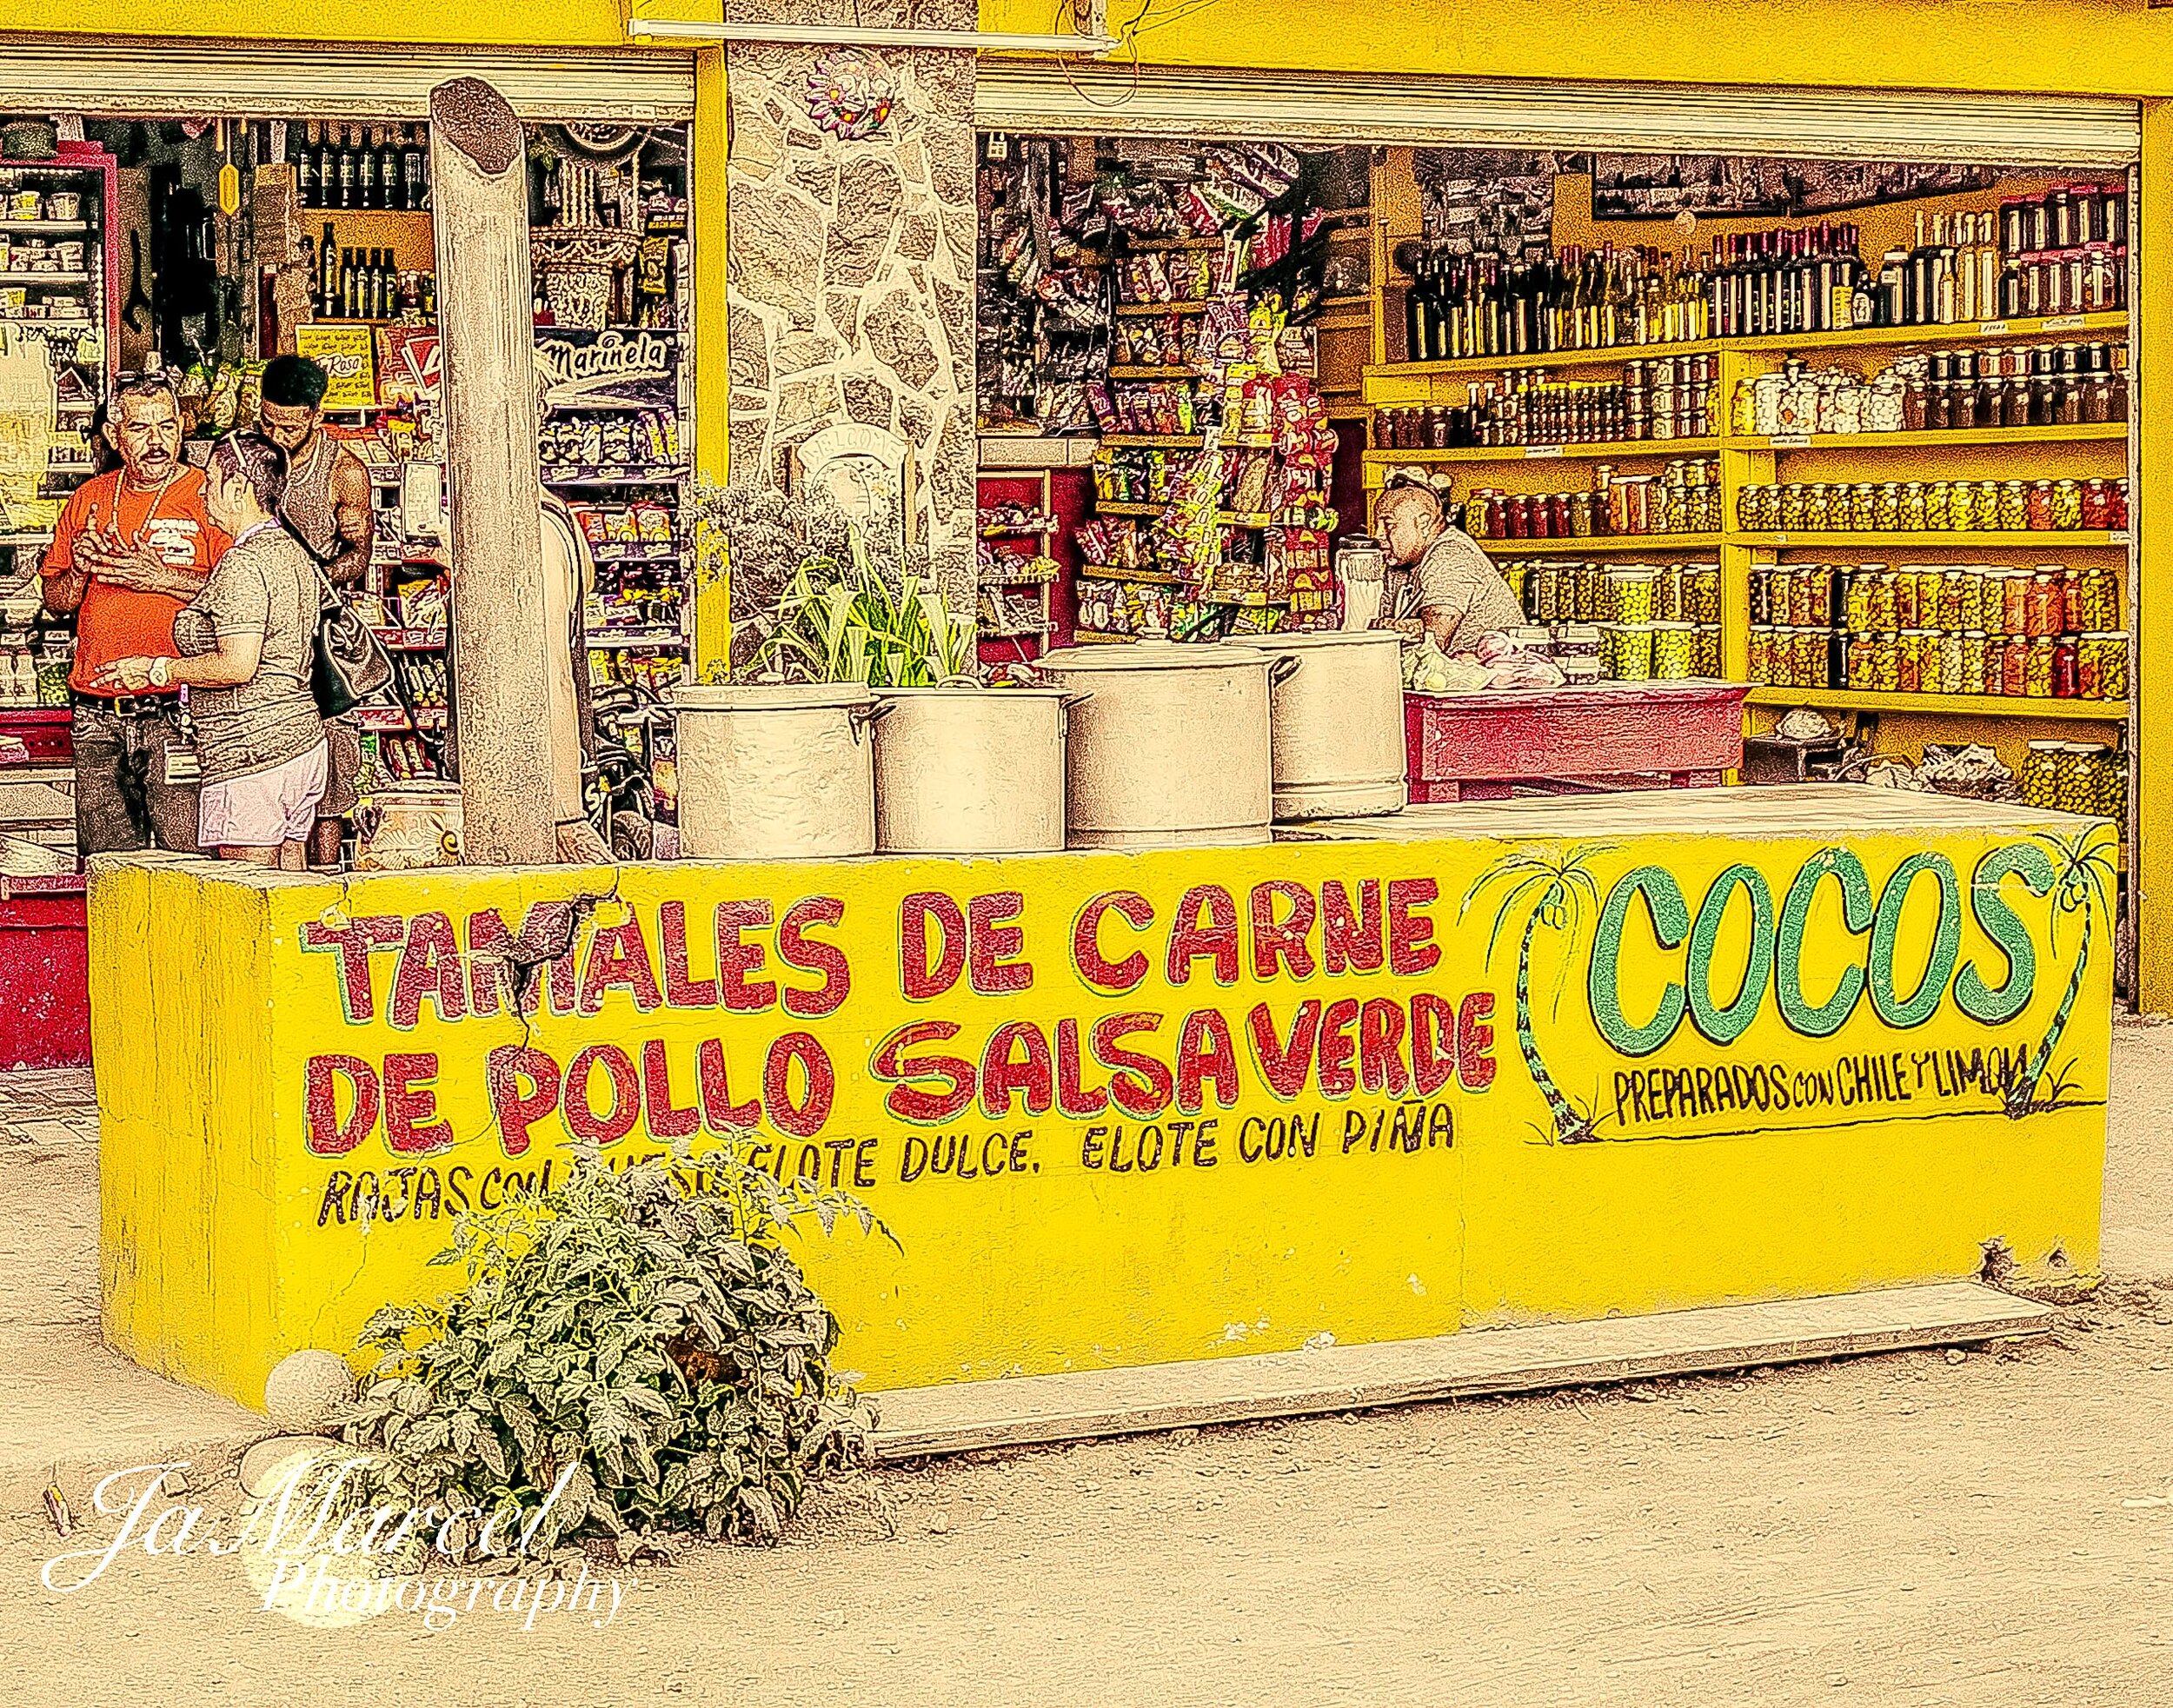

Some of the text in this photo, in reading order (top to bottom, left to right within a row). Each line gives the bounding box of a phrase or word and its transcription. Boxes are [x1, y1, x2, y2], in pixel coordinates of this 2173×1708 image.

[327, 355, 360, 375] Rosa
[540, 334, 664, 381] Marinela
[301, 877, 1440, 1029] TAMALES DE CARNE
[1588, 843, 2057, 1057] COCOS
[304, 992, 1497, 1160] DE POLLO SALSA VERDE
[1614, 1064, 1791, 1126] PREPARADOS
[1793, 1069, 1834, 1108] CON
[1837, 1052, 1912, 1107] CHILE
[1931, 1043, 2028, 1104] LIMON
[317, 1165, 474, 1227] RAJAS
[1082, 1118, 1219, 1173] ELOTE
[1239, 1112, 1321, 1163] CON
[1342, 1099, 1453, 1154] PIÑA
